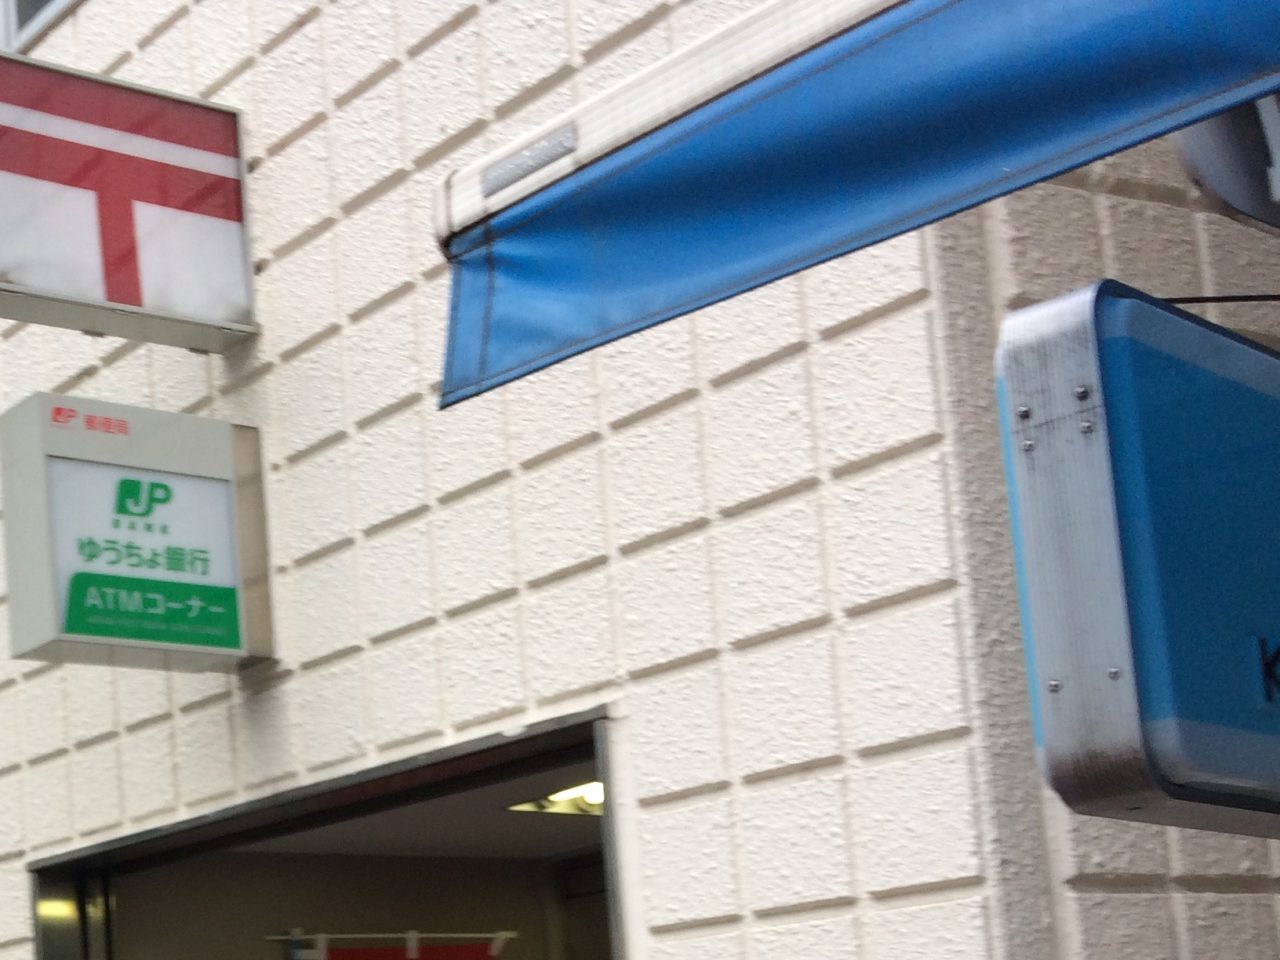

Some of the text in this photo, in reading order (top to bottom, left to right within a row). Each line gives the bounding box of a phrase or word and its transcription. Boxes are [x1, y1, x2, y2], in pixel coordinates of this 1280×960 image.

[115, 478, 173, 517] JP
[77, 537, 211, 576] ゆうちょ銀行
[83, 585, 227, 617] ATMコーナー
